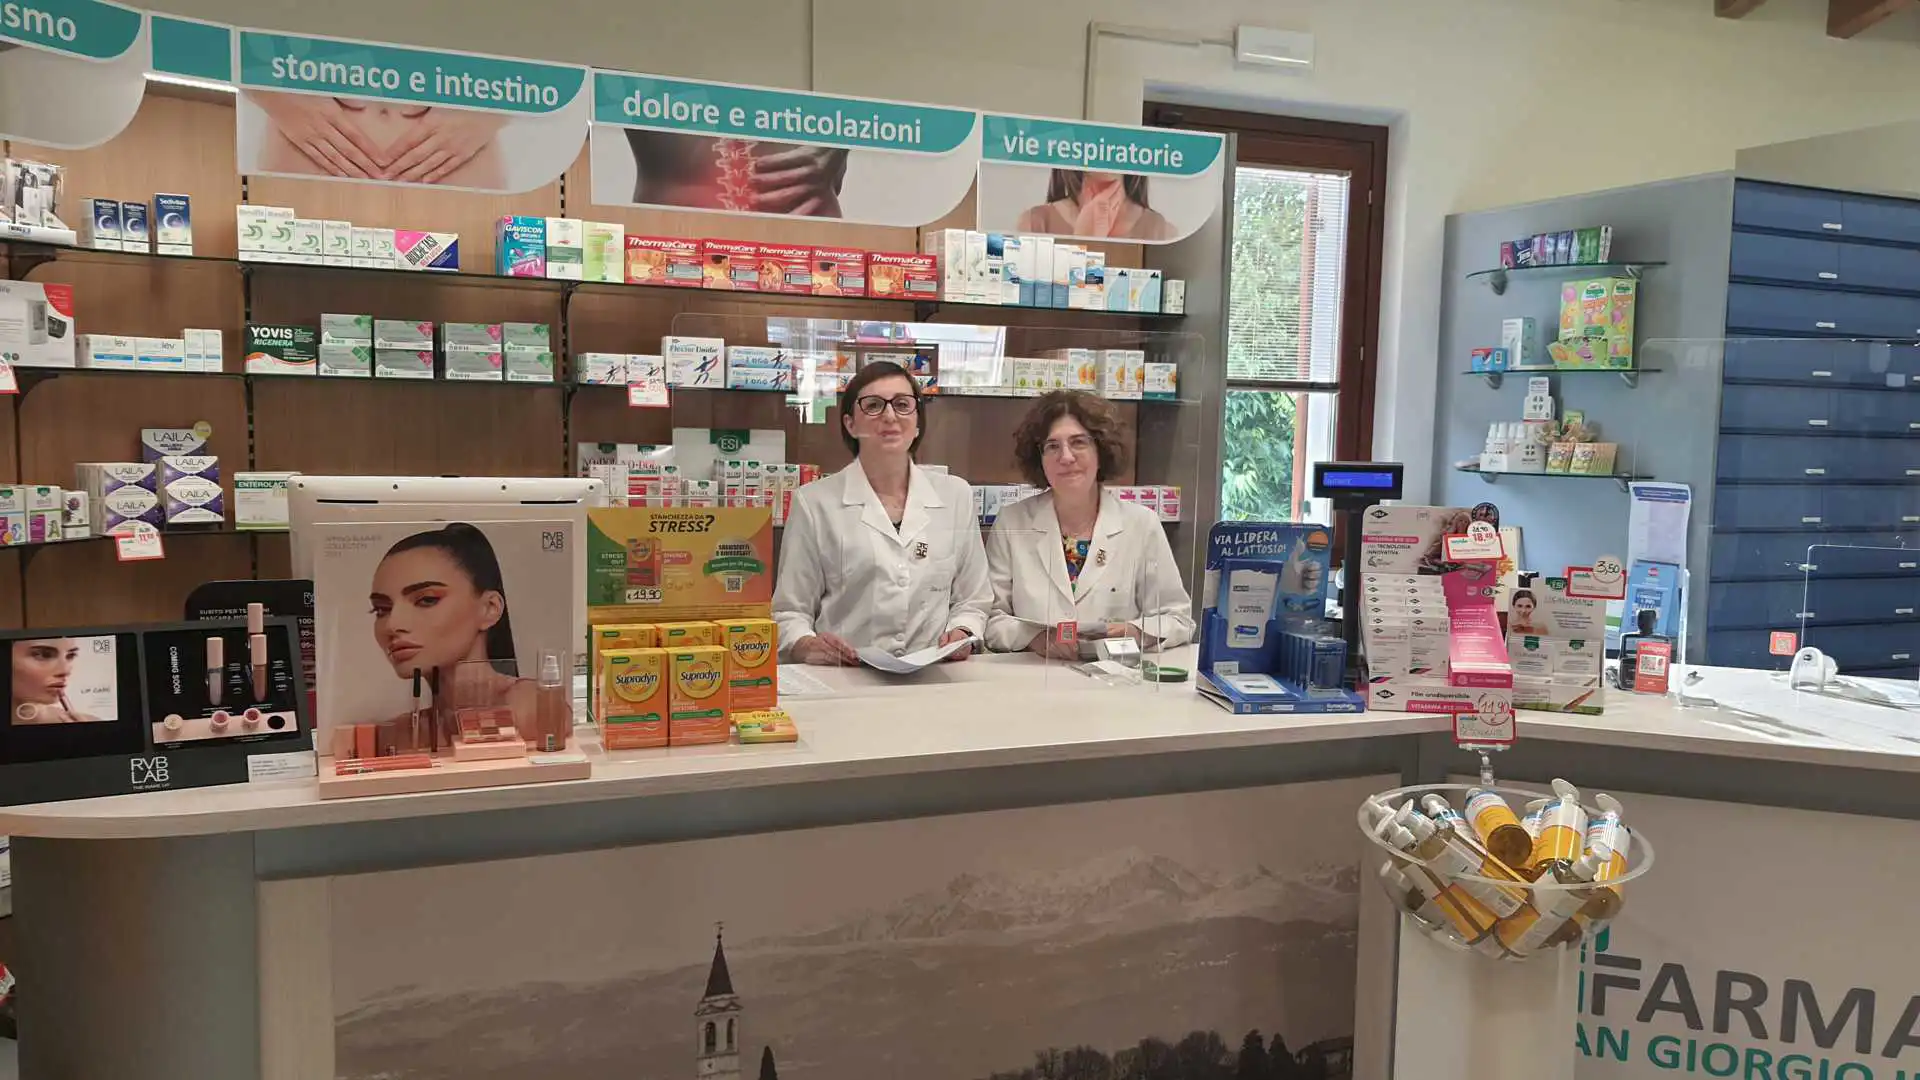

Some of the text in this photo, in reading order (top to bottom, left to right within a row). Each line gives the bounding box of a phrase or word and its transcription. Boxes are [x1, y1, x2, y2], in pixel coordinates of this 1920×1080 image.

[0, 3, 76, 41] smo
[271, 53, 560, 107] stomaco e intestino
[622, 89, 922, 144] dolore e articolazioni
[1003, 130, 1184, 169] vie respiratorie
[505, 225, 543, 234] GAVISCON
[628, 237, 697, 250] ThermaCare
[705, 242, 756, 253] ThermaCare
[759, 246, 810, 257] ThermaCare
[814, 250, 864, 260] ThermaCare
[871, 253, 932, 265] ThermaCare
[250, 327, 293, 339] YOVIS
[254, 339, 293, 347] RIGENERA
[153, 432, 194, 442] LAILA
[721, 438, 739, 450] ESI
[175, 458, 206, 466] LAILA
[115, 467, 144, 475] LAILA
[179, 489, 210, 498] LAILA
[116, 501, 146, 510] LAILA
[649, 515, 715, 533] STRESS?
[542, 532, 564, 541] RVB
[1214, 531, 1278, 546] VIA LIBERA
[542, 540, 564, 550] LAB
[1221, 544, 1287, 556] AL LATTOSIO!
[733, 641, 769, 652] Supradyn
[169, 646, 179, 673] COMING
[615, 672, 658, 685] Supradyn
[680, 671, 721, 683] Supradyn
[130, 756, 168, 771] RVB
[131, 769, 170, 784] LAB
